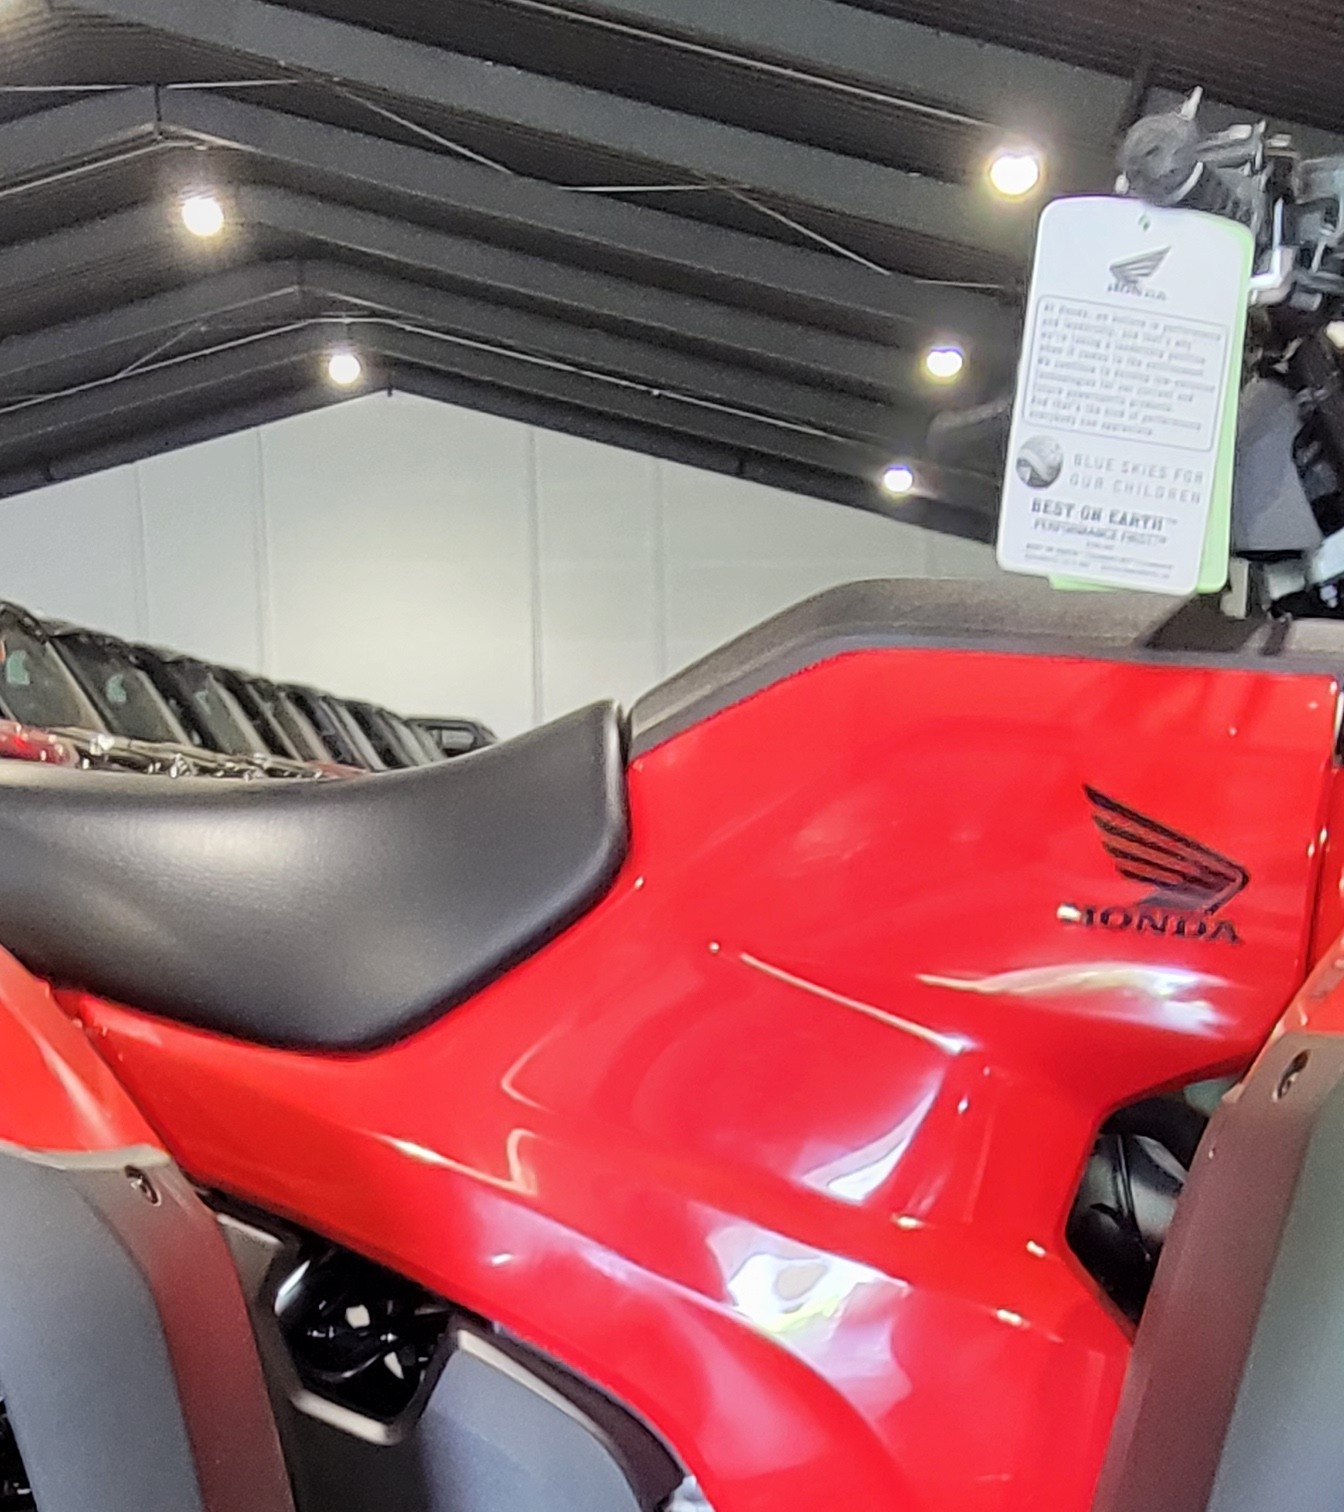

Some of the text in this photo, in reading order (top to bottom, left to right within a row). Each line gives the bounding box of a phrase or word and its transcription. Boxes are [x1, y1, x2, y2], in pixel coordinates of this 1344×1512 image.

[1106, 281, 1167, 301] HONDA
[1073, 453, 1204, 485] BLUE SKIES FOR
[1069, 473, 1201, 505] OUR CHILDREN
[1031, 497, 1076, 518] BEST
[1080, 504, 1104, 523] ON
